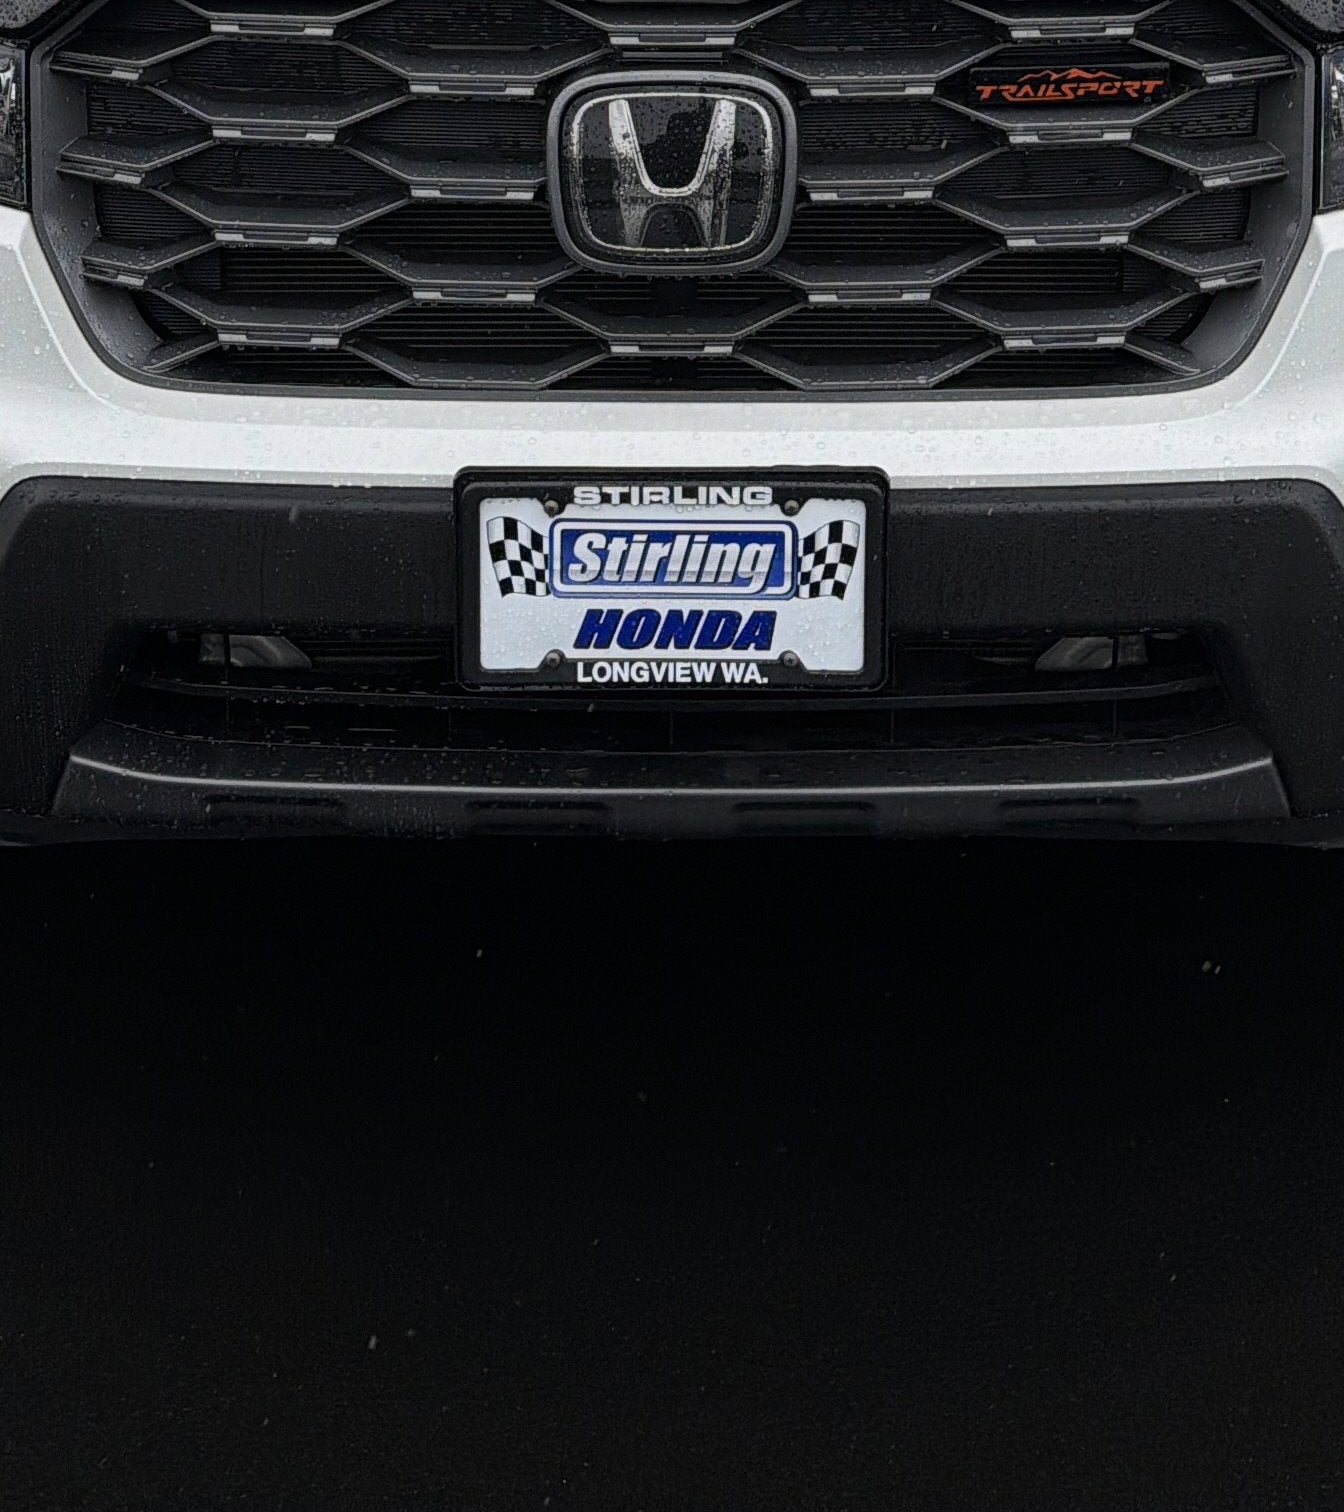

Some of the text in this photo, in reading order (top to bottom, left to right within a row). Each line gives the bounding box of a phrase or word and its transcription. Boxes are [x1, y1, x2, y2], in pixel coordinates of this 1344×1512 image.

[975, 80, 1165, 101] TRAILSPORT
[572, 486, 774, 506] STIRLING
[567, 531, 777, 595] Stirling
[573, 608, 778, 651] HONDA
[576, 661, 770, 685] LONGVIEW WA.
